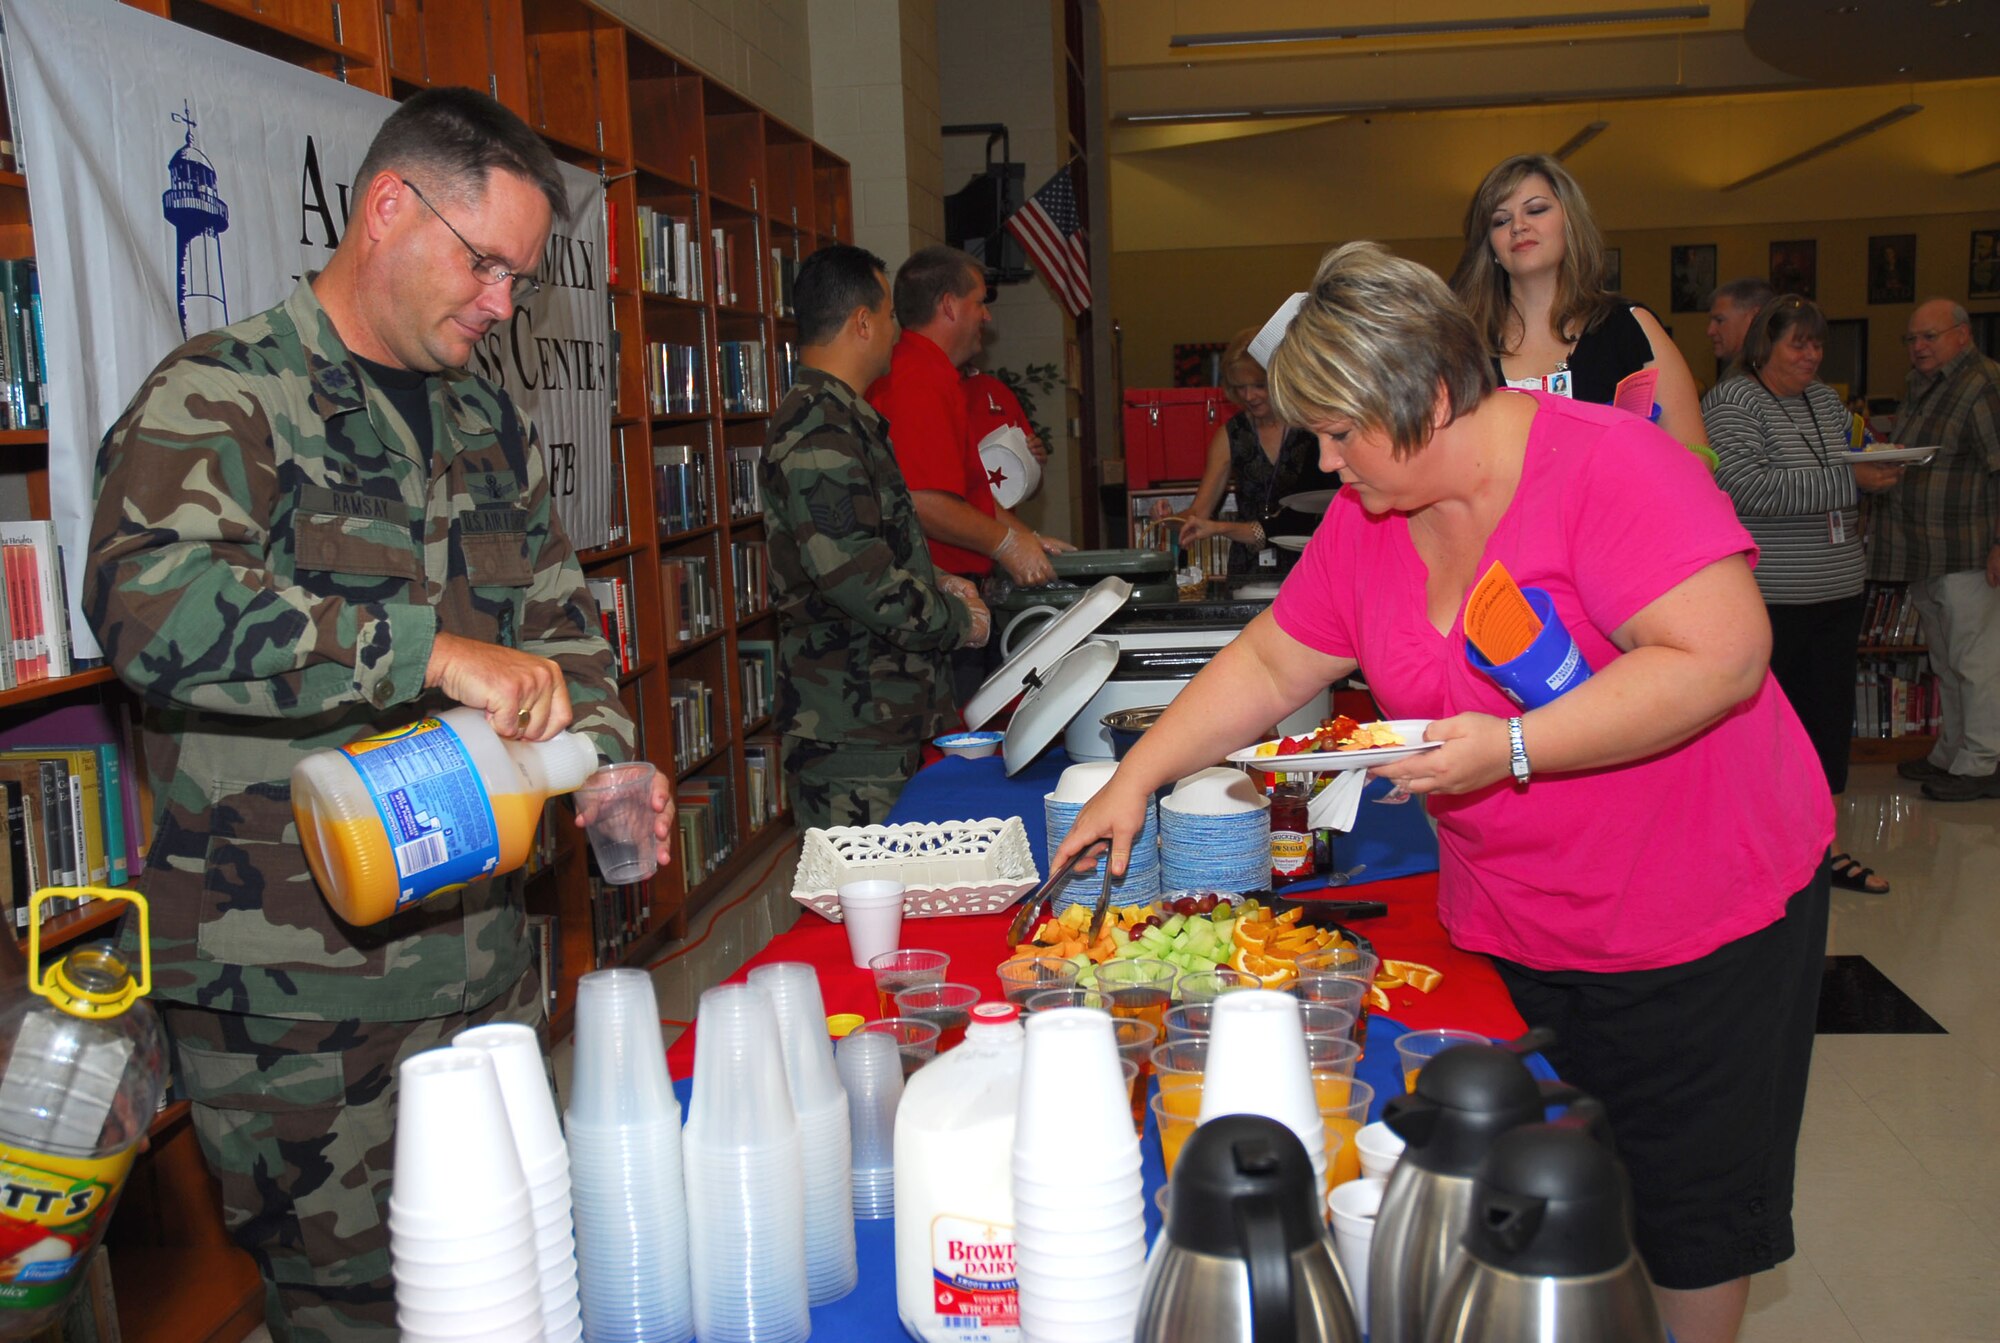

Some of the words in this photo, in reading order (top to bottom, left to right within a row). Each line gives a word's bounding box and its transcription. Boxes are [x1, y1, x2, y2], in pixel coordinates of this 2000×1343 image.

[539, 233, 595, 291] MILY
[549, 442, 576, 498] FB
[332, 490, 389, 518] RAMSAY
[965, 1262, 1017, 1275] DAIRY
[957, 1275, 989, 1290] SMOOTH
[958, 1303, 1000, 1316] WHOLE
[1002, 1302, 1018, 1315] MI
